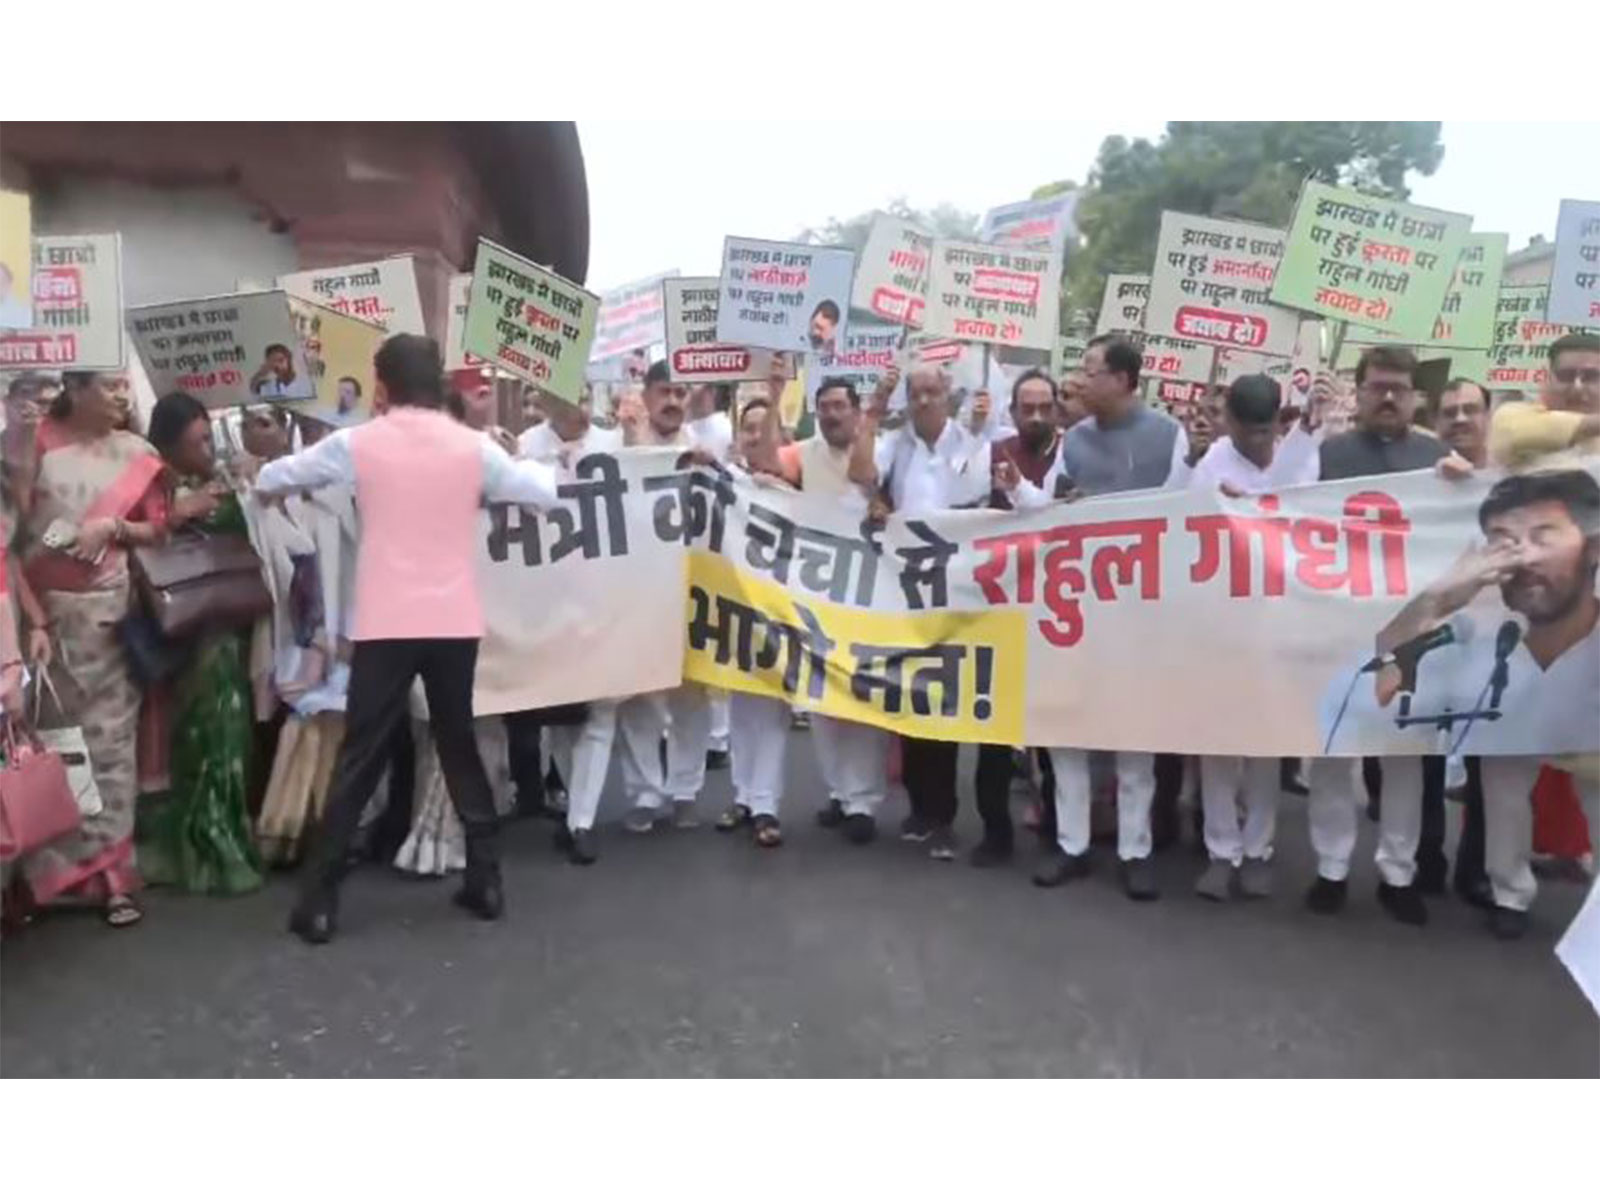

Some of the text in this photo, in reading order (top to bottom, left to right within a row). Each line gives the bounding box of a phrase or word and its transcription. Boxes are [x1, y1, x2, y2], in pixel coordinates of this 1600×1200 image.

[1167, 251, 1187, 268] पर
[1310, 225, 1332, 246] पर
[1414, 250, 1439, 271] पर
[1180, 278, 1198, 296] पर
[1200, 280, 1238, 307] राहुल
[1317, 257, 1411, 296] राहुल गांधी
[744, 502, 882, 608] चर्चा
[898, 520, 958, 610] से
[972, 517, 1168, 649] राहुल
[1186, 491, 1413, 599] गांधी
[688, 585, 836, 702] भागो
